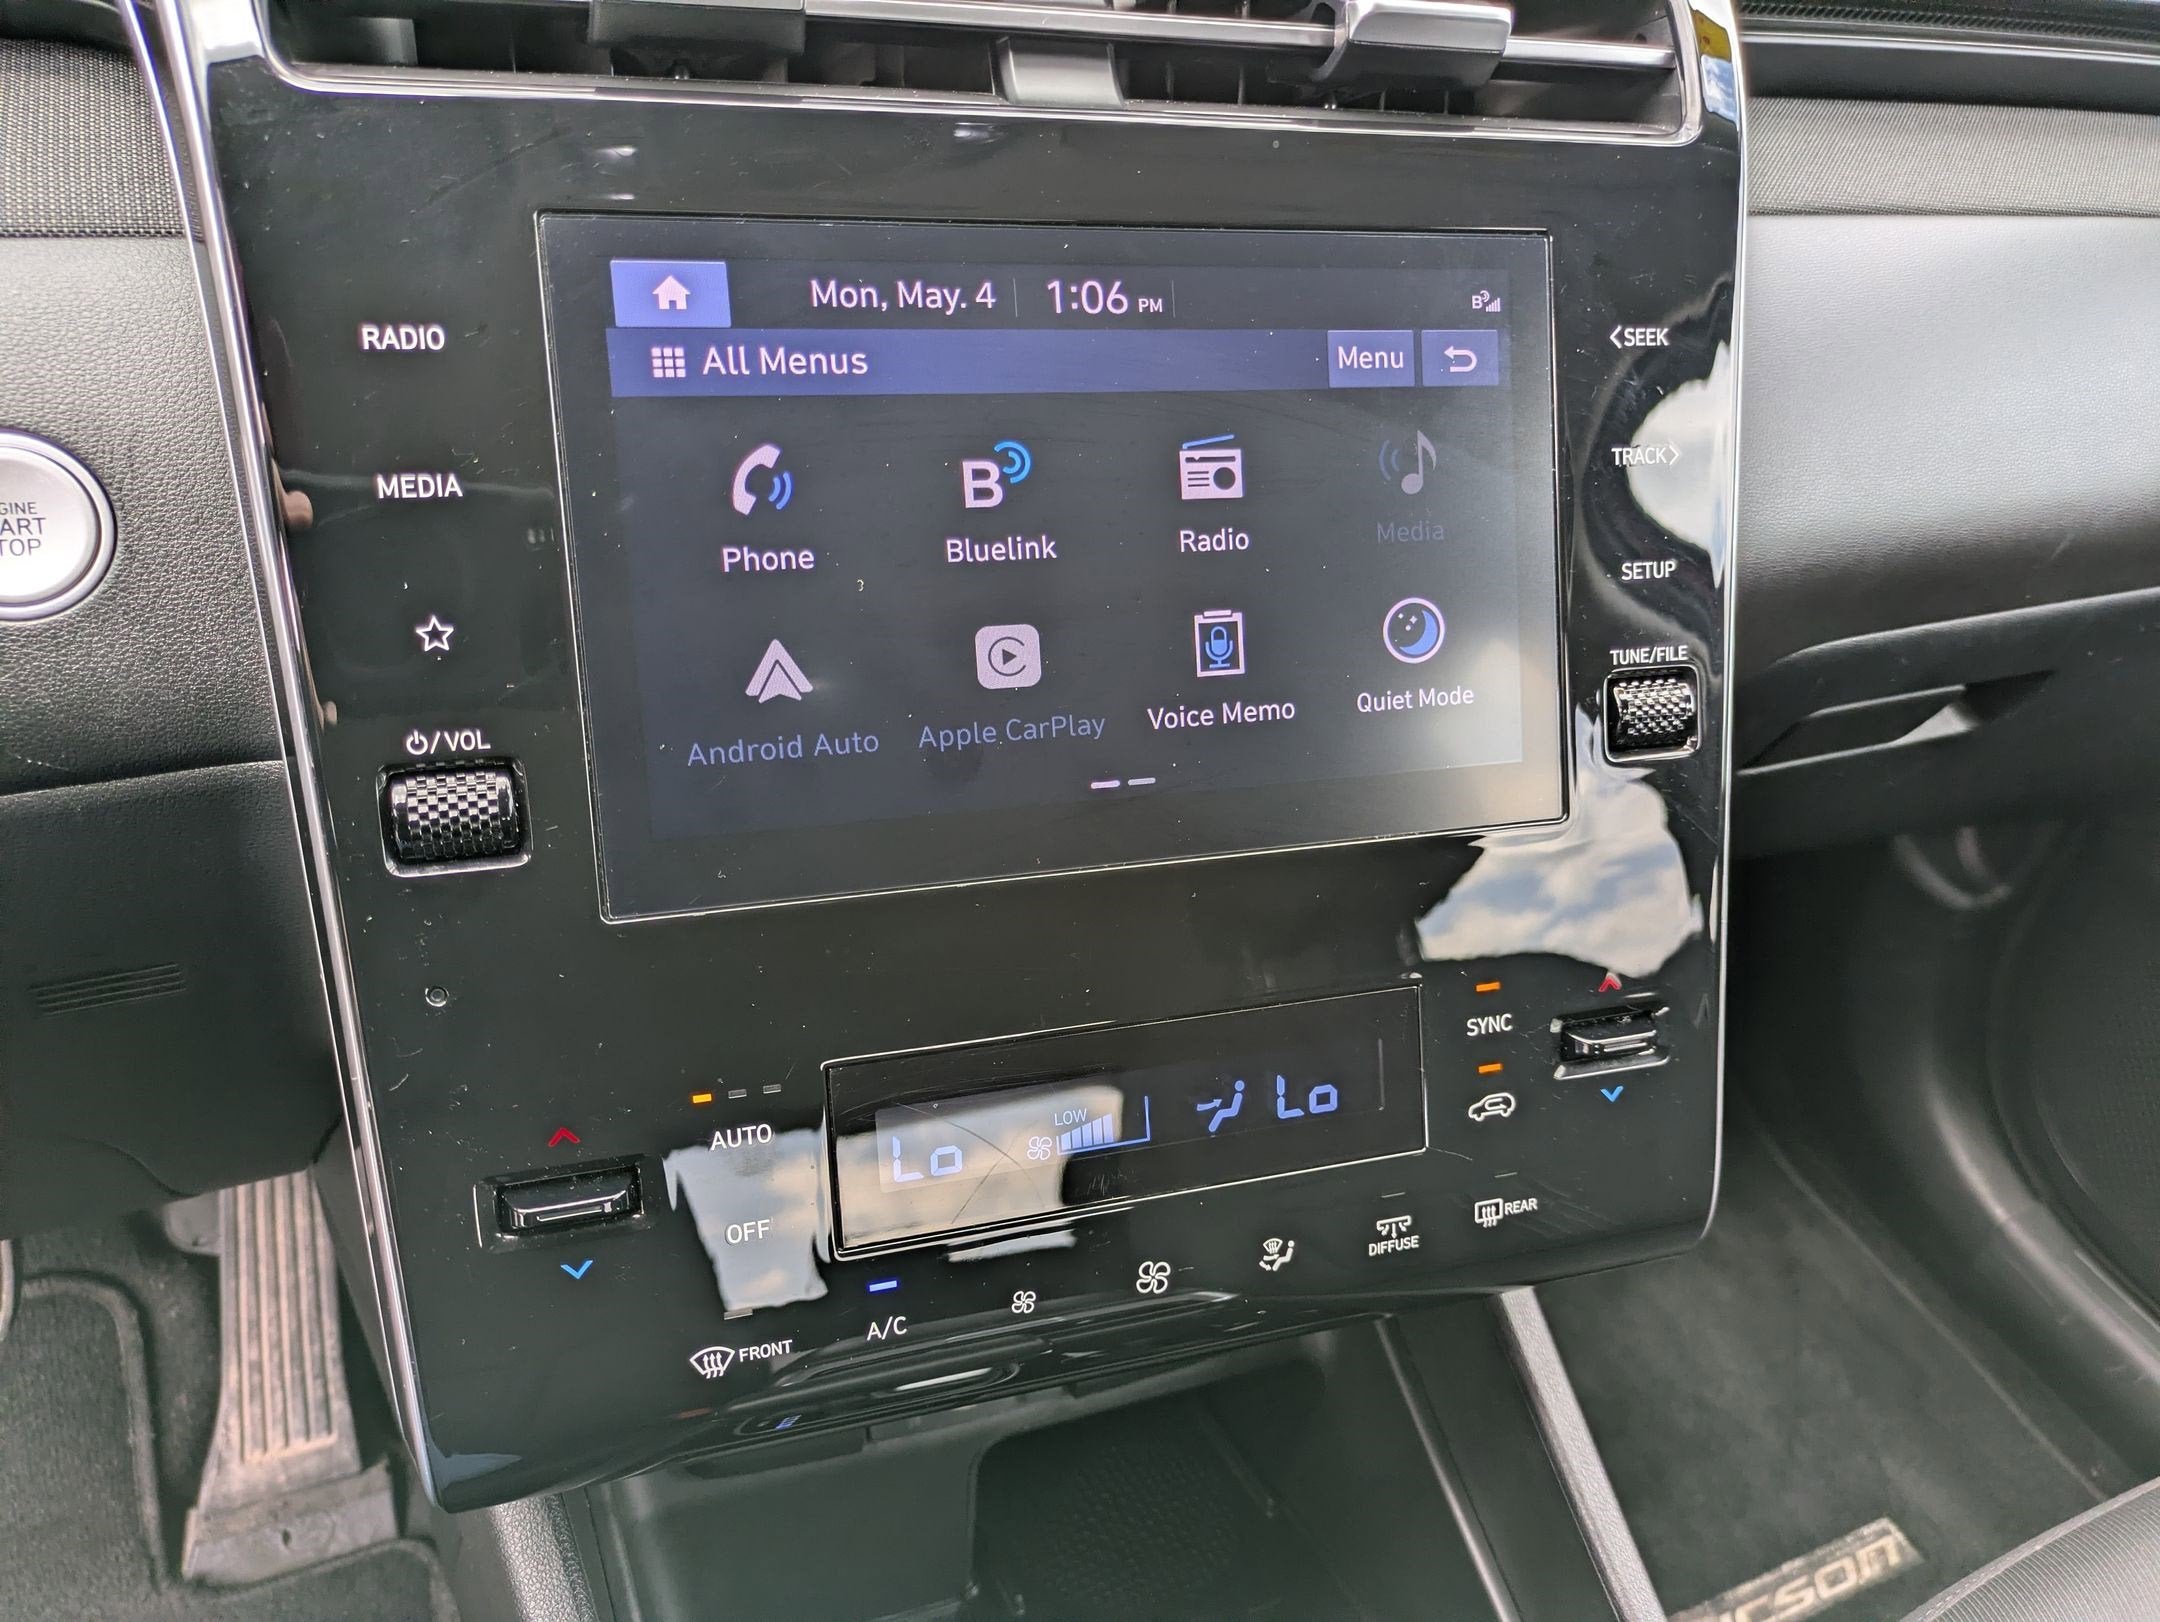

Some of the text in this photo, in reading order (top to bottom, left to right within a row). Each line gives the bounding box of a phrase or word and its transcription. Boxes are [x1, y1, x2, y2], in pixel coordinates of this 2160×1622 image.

[810, 279, 997, 316] Mon, May. 4
[1046, 280, 1163, 316] 1:06 PM
[360, 324, 446, 351] RADIO
[1623, 327, 1670, 348] SEEK
[702, 346, 869, 376] All Menus
[1337, 346, 1405, 371] Menu
[1611, 446, 1668, 466] TRACK
[376, 473, 464, 499] MEDIA
[1179, 529, 1251, 554] Radio
[1376, 519, 1446, 544] Media
[721, 546, 816, 573] Phone
[945, 534, 1058, 564] Bluelink
[1621, 560, 1677, 581] SETUP
[1609, 645, 1689, 666] TUNE/FILE
[1356, 686, 1475, 714] Quiet Mode
[1147, 699, 1297, 731] Voice Memo
[918, 714, 1107, 753] Apple CarPlay
[687, 731, 881, 767] Android Auto
[1465, 1012, 1514, 1037] SYNC
[1053, 1107, 1089, 1127] LOW
[708, 1122, 773, 1152] AUTO
[1504, 1197, 1539, 1216] REAR
[724, 1217, 772, 1245] OFF
[1368, 1234, 1420, 1257] DIFFUSE
[866, 1315, 909, 1342] A/C
[737, 1339, 793, 1362] FRONT
